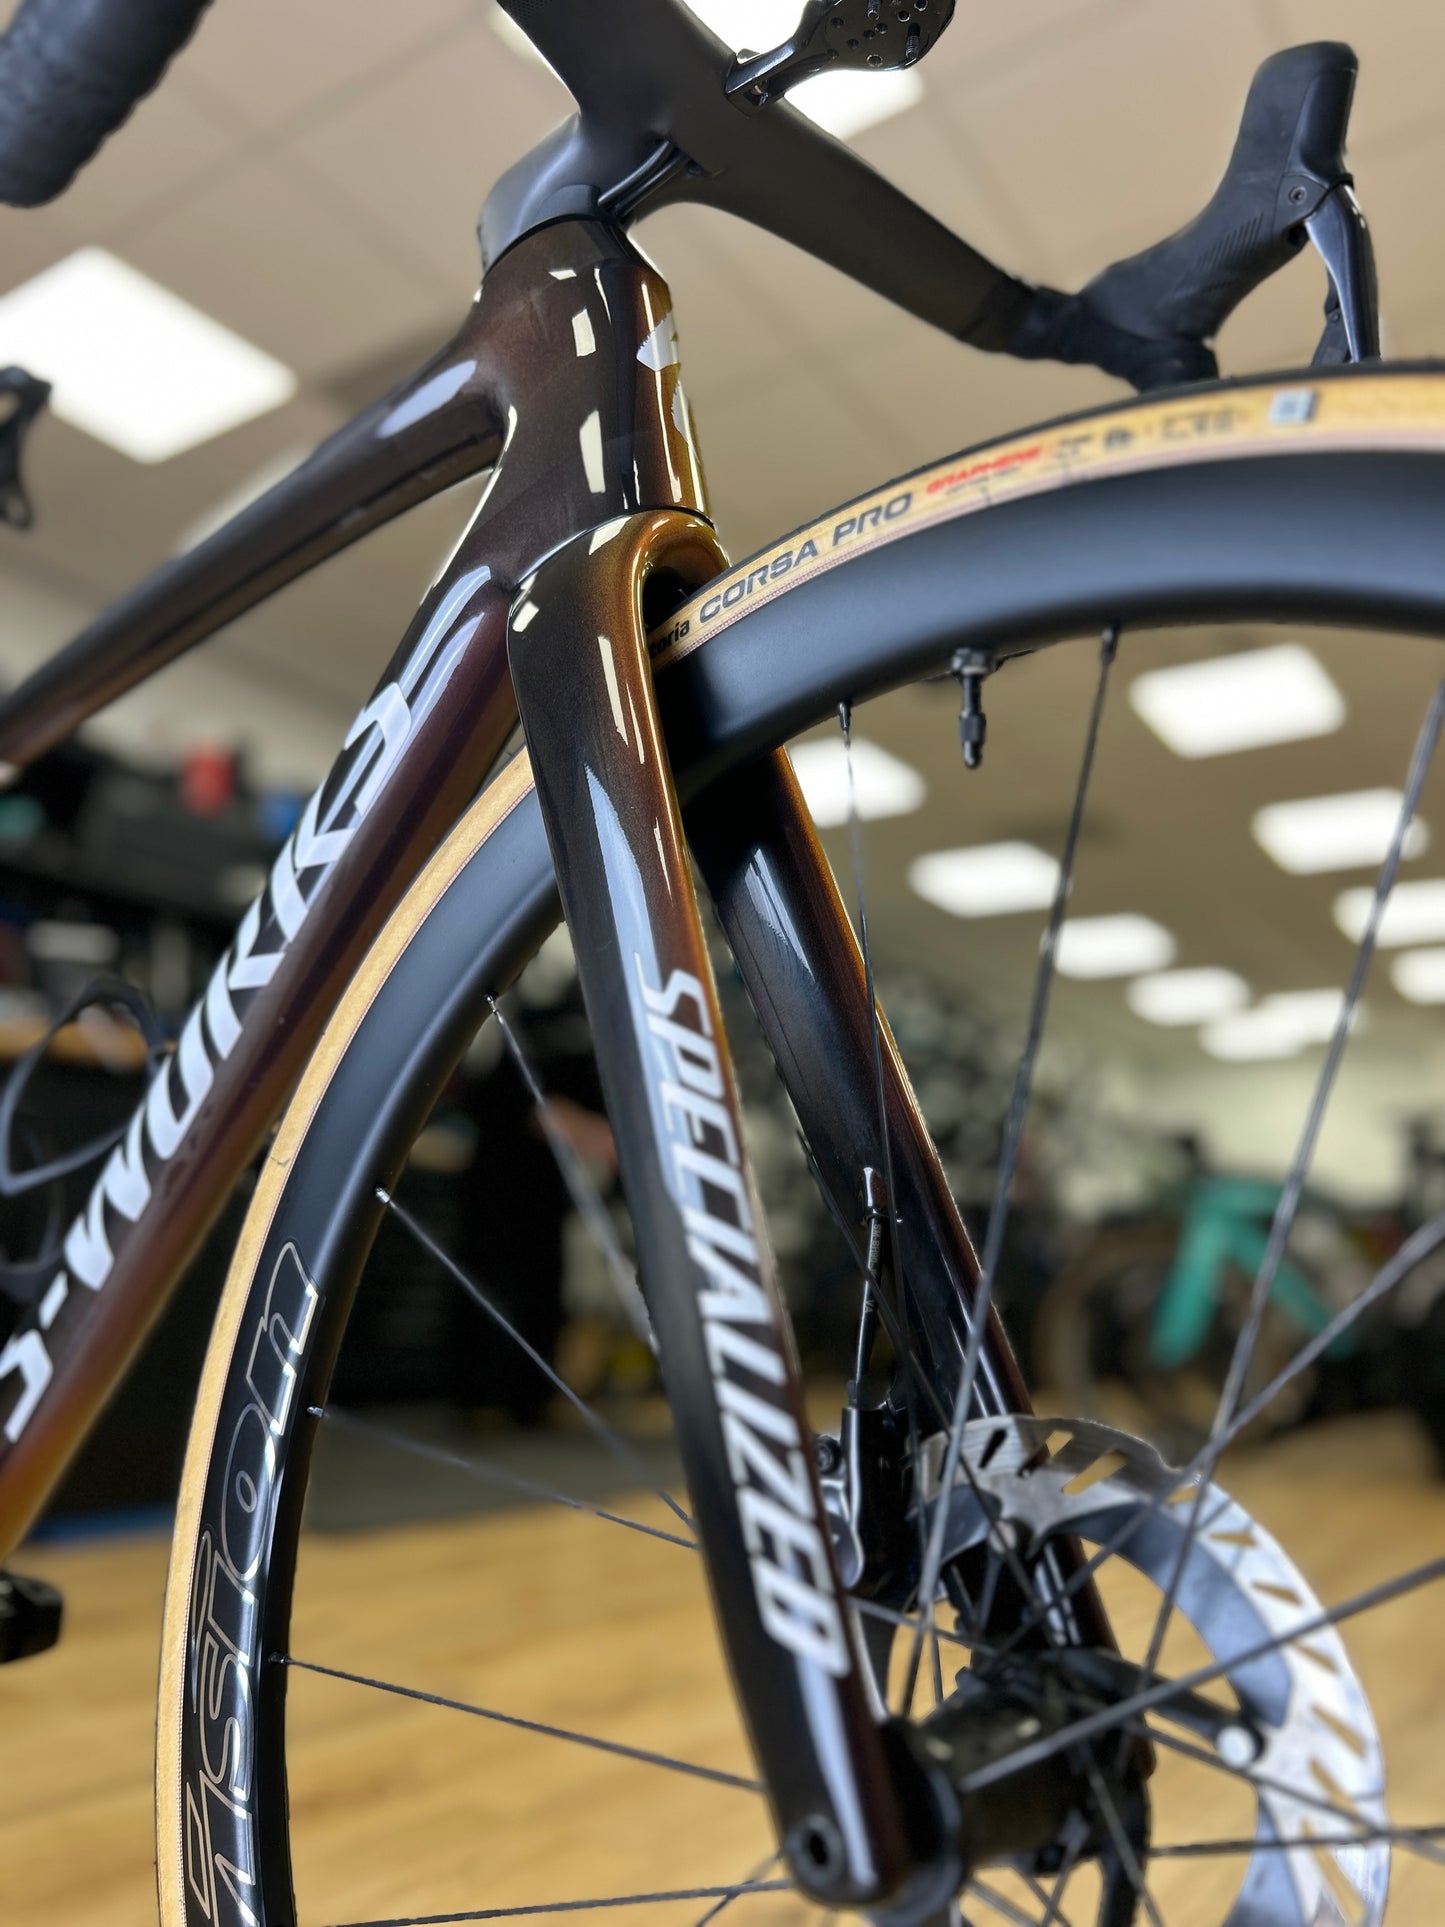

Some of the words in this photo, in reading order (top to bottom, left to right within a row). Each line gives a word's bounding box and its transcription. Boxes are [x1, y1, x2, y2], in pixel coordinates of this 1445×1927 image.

[649, 620, 690, 659] toria
[699, 539, 818, 624] CORSA
[832, 493, 913, 546] PRO
[186, 1241, 319, 1927] ision
[634, 951, 852, 1679] SPECIALIZED
